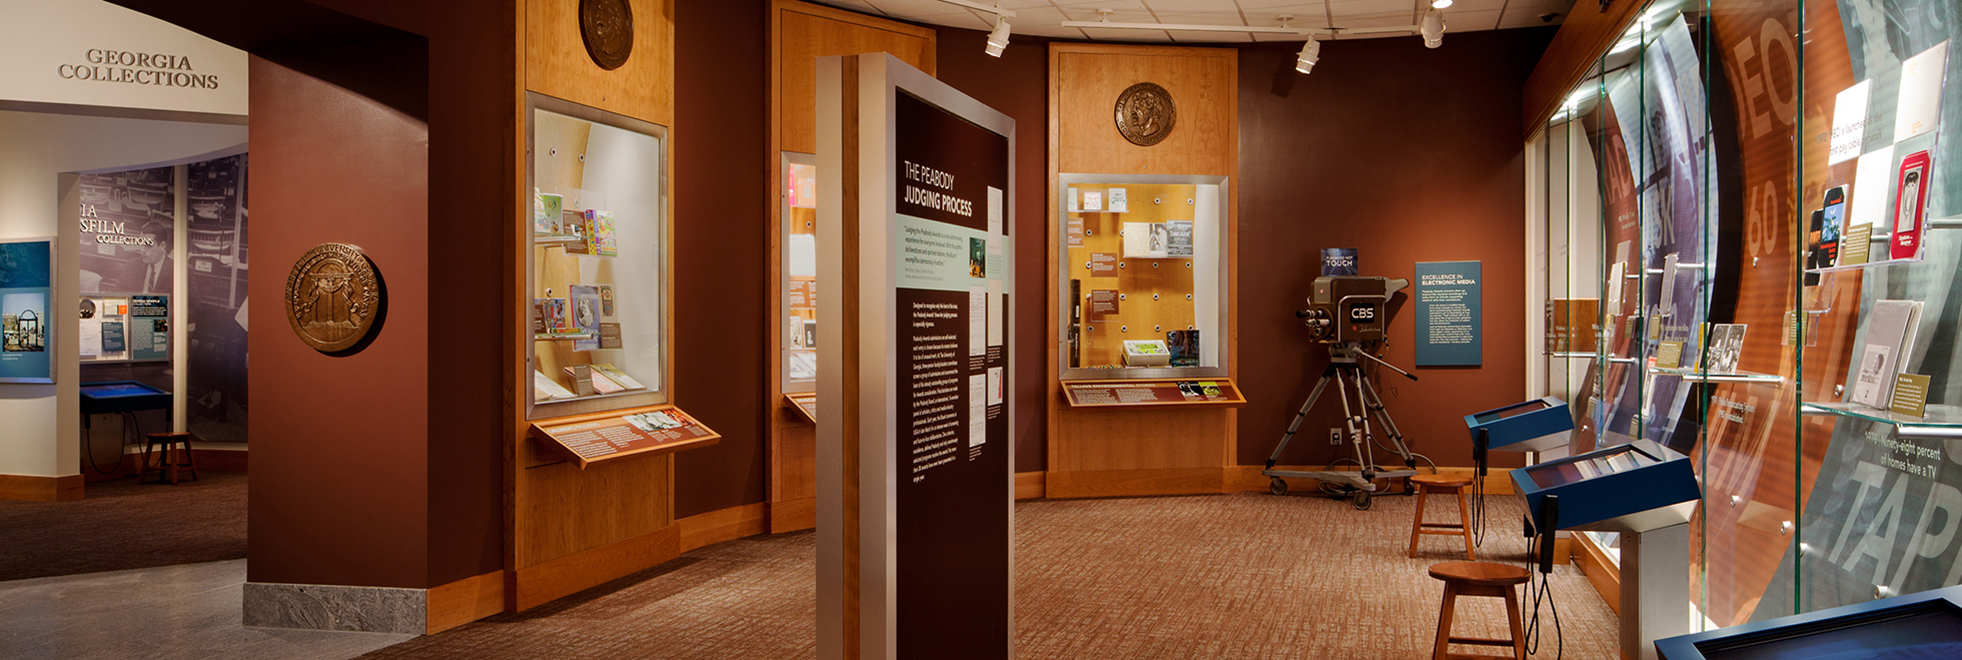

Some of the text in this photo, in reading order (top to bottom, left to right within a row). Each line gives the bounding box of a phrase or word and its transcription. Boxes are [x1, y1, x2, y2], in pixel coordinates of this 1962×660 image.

[85, 48, 193, 70] GEORGIA
[57, 63, 218, 90] COLLECTIONS
[904, 160, 955, 191] THE PEABODY
[904, 185, 973, 218] JUDGING PROCESS
[96, 234, 154, 247] COLLECTIONS
[1352, 308, 1374, 319] CBS
[1881, 434, 1916, 456] Ninety-eight
[1917, 445, 1941, 460] percent
[1881, 452, 1937, 479] of homes have a TV
